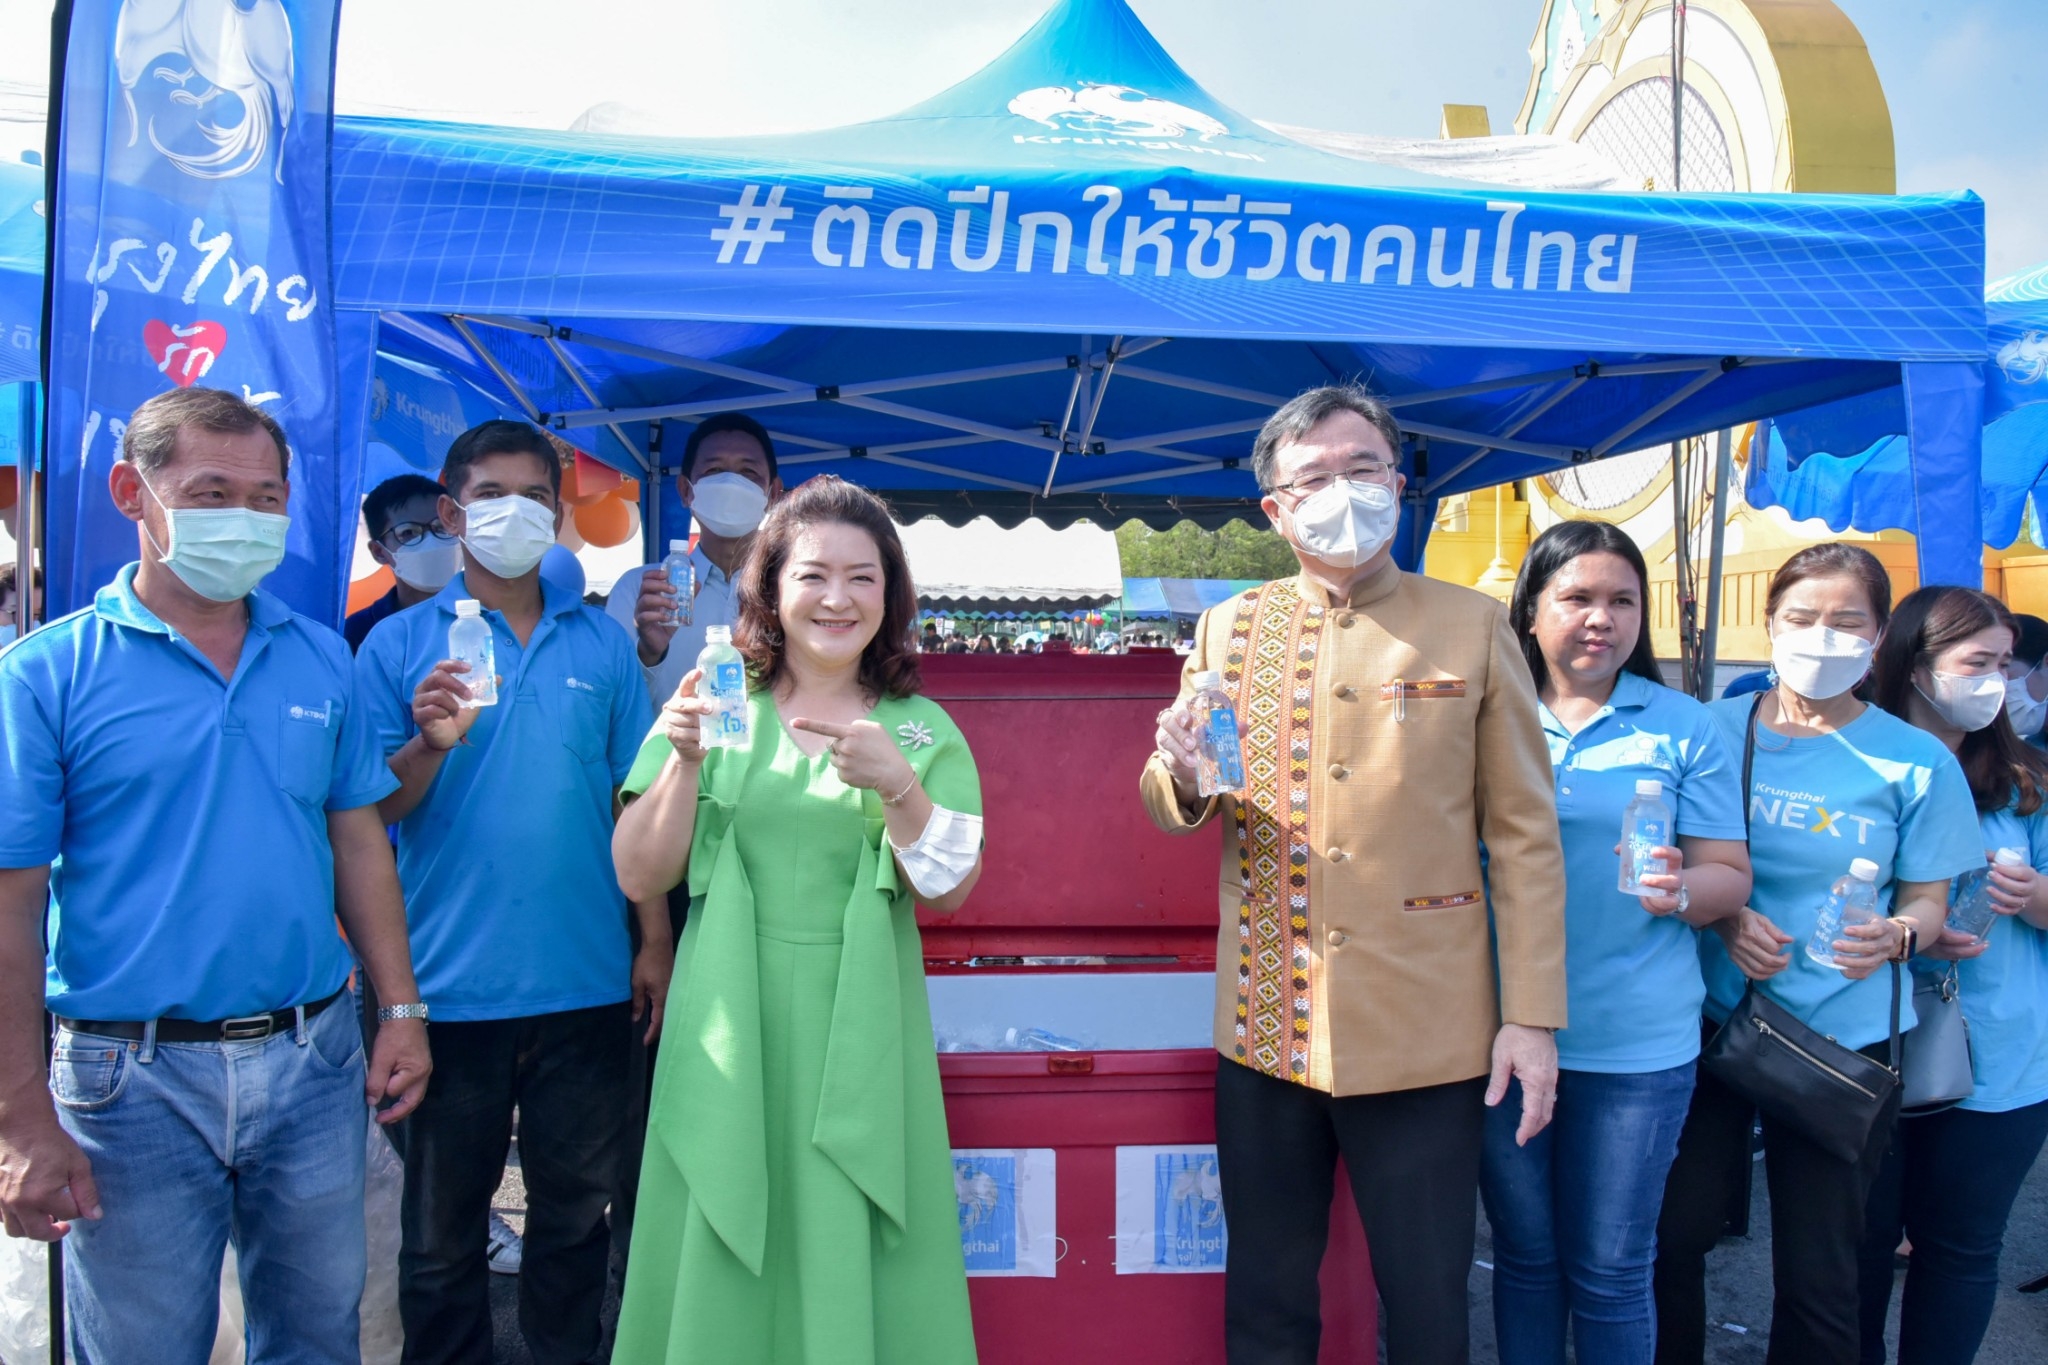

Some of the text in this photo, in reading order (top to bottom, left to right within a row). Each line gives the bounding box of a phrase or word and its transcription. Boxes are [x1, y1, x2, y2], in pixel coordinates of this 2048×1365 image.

[1013, 135, 1266, 163] Krungthai
[710, 185, 1638, 293] #ติดปีกให้ชีวิตคนไทย
[158, 324, 207, 378] รัก
[1755, 782, 1826, 803] Krungthai
[1750, 795, 1876, 845] NEXT
[962, 1239, 1000, 1257] gthai
[1176, 1236, 1221, 1253] Krungt
